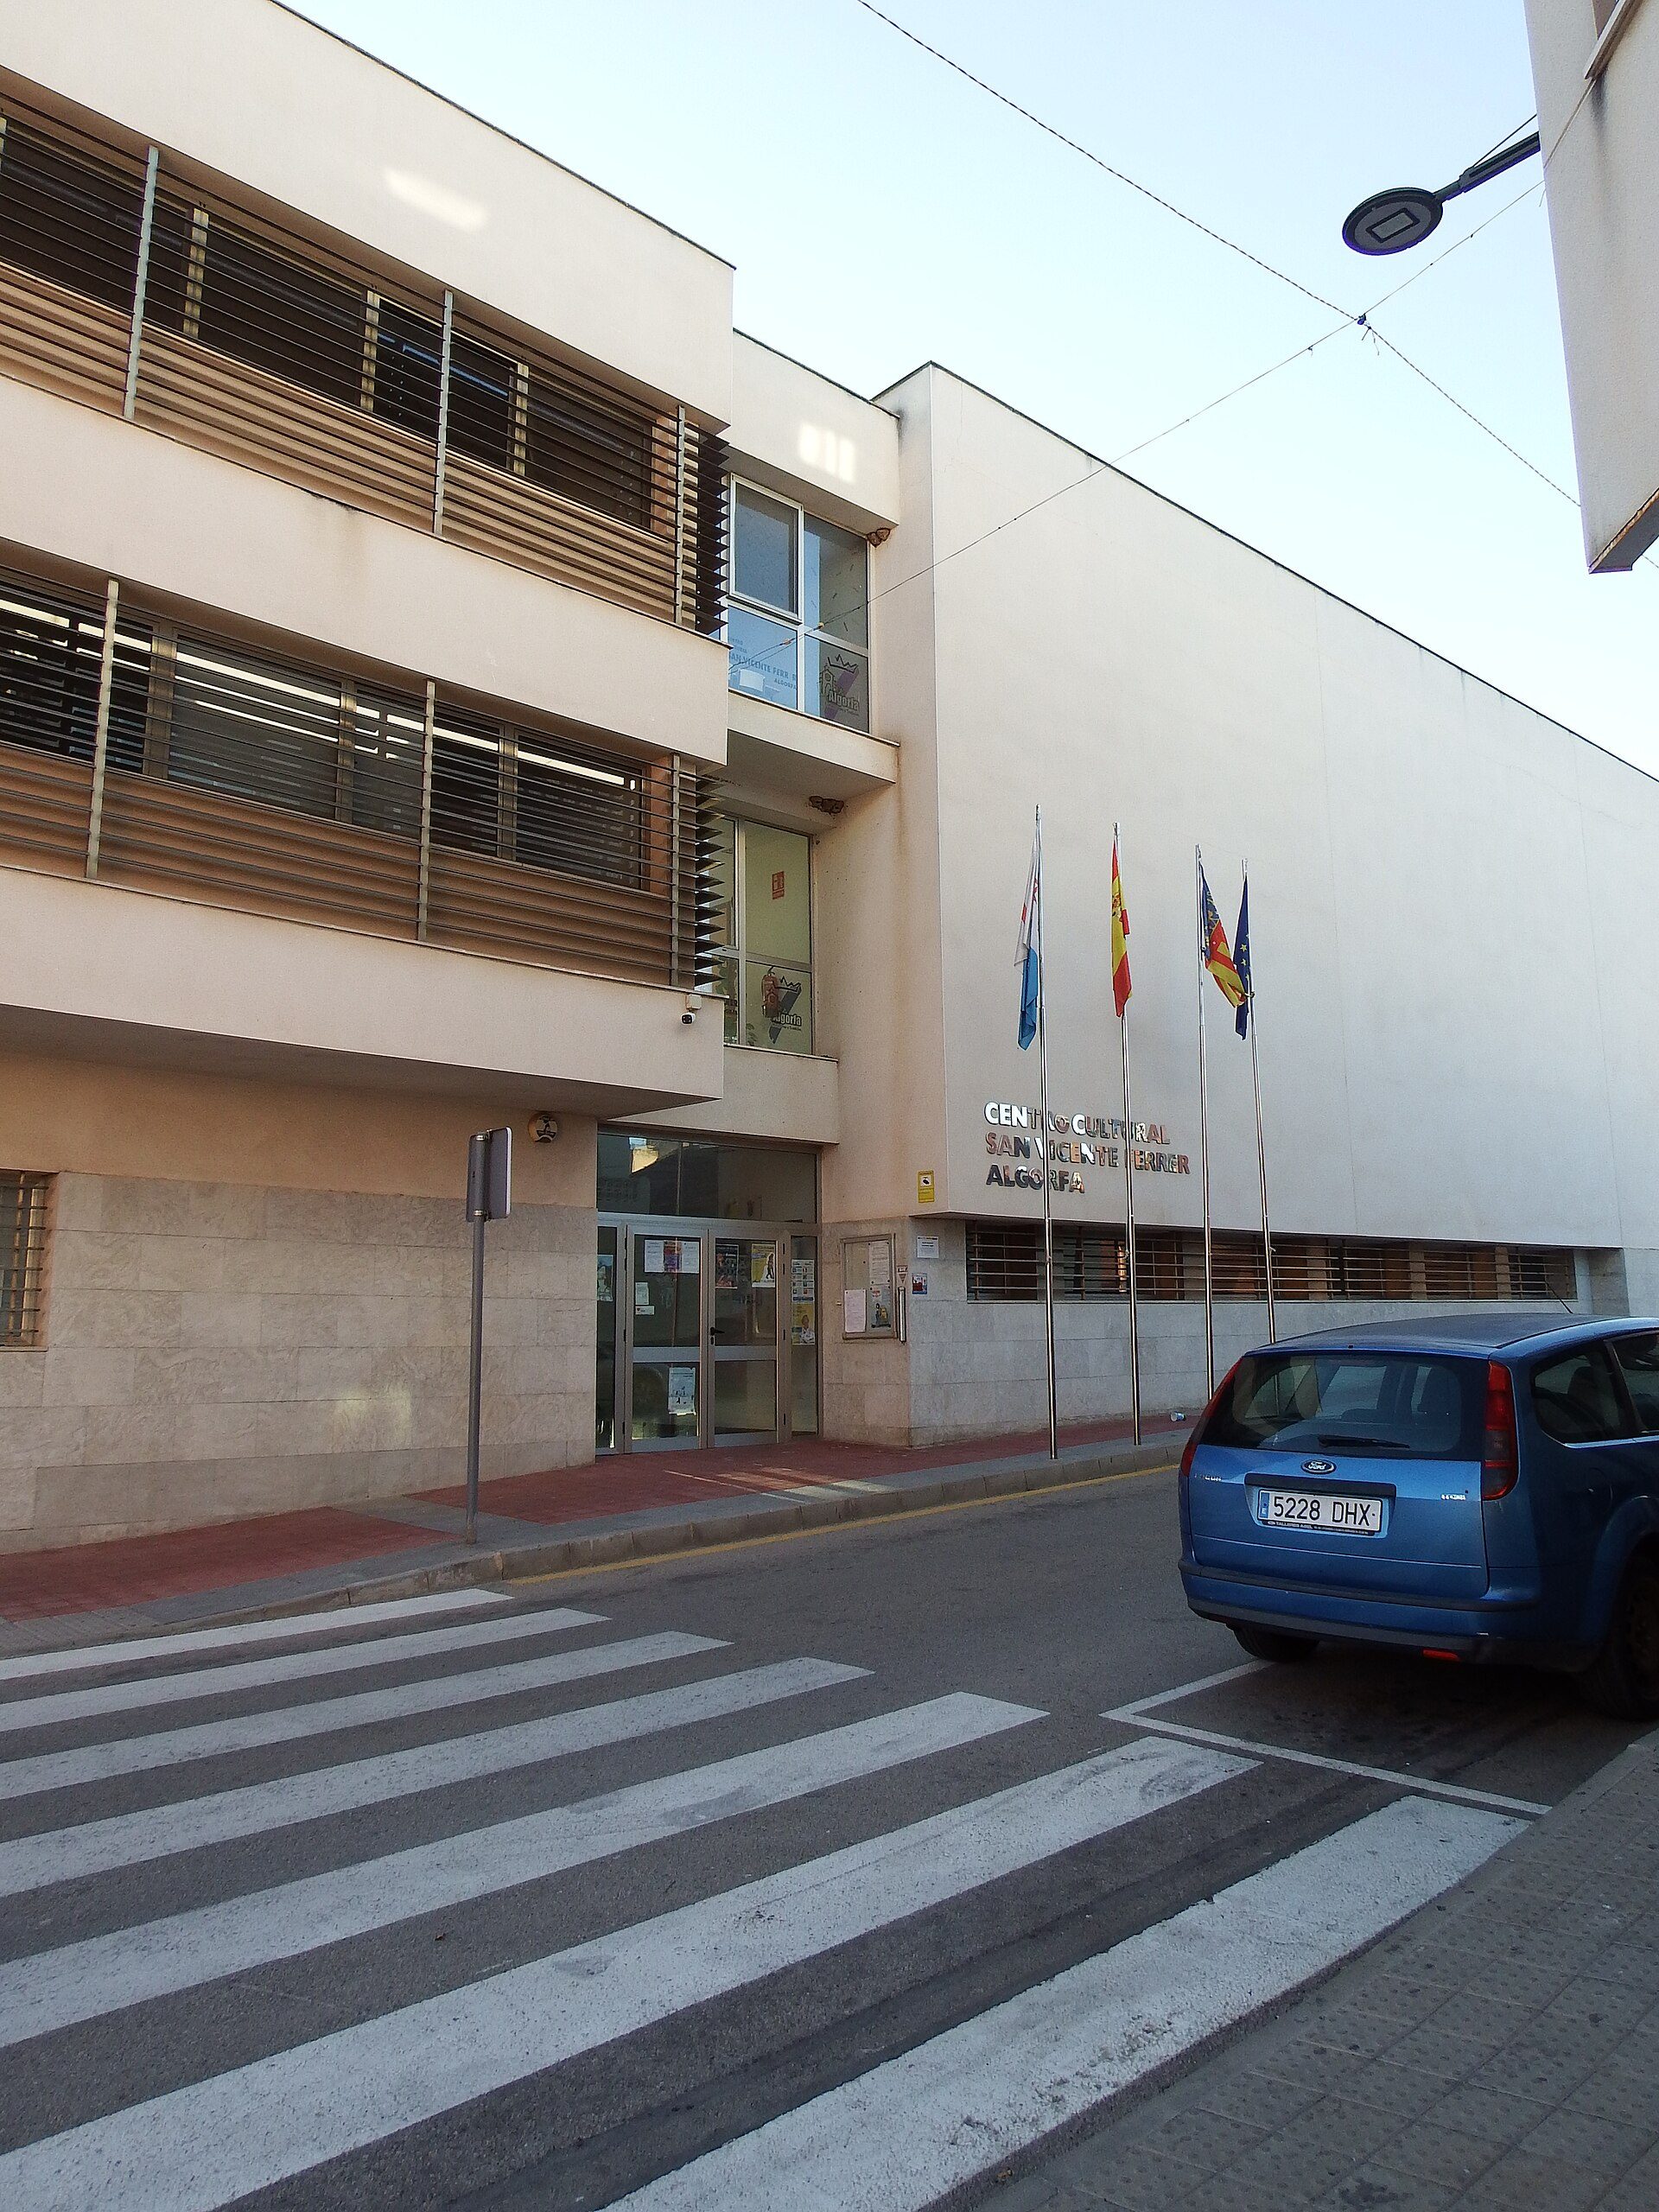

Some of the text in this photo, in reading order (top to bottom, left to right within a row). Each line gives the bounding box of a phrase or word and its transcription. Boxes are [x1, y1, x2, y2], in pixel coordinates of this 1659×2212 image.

[1071, 1112, 1171, 1145] CULTURAL
[985, 1131, 1031, 1159] SAN
[1033, 1136, 1119, 1168] VICENTE
[985, 1162, 1085, 1193] ALGORFA
[1308, 1460, 1327, 1470] Ford
[1274, 1496, 1320, 1521] 5228
[1332, 1501, 1371, 1527] DHX
